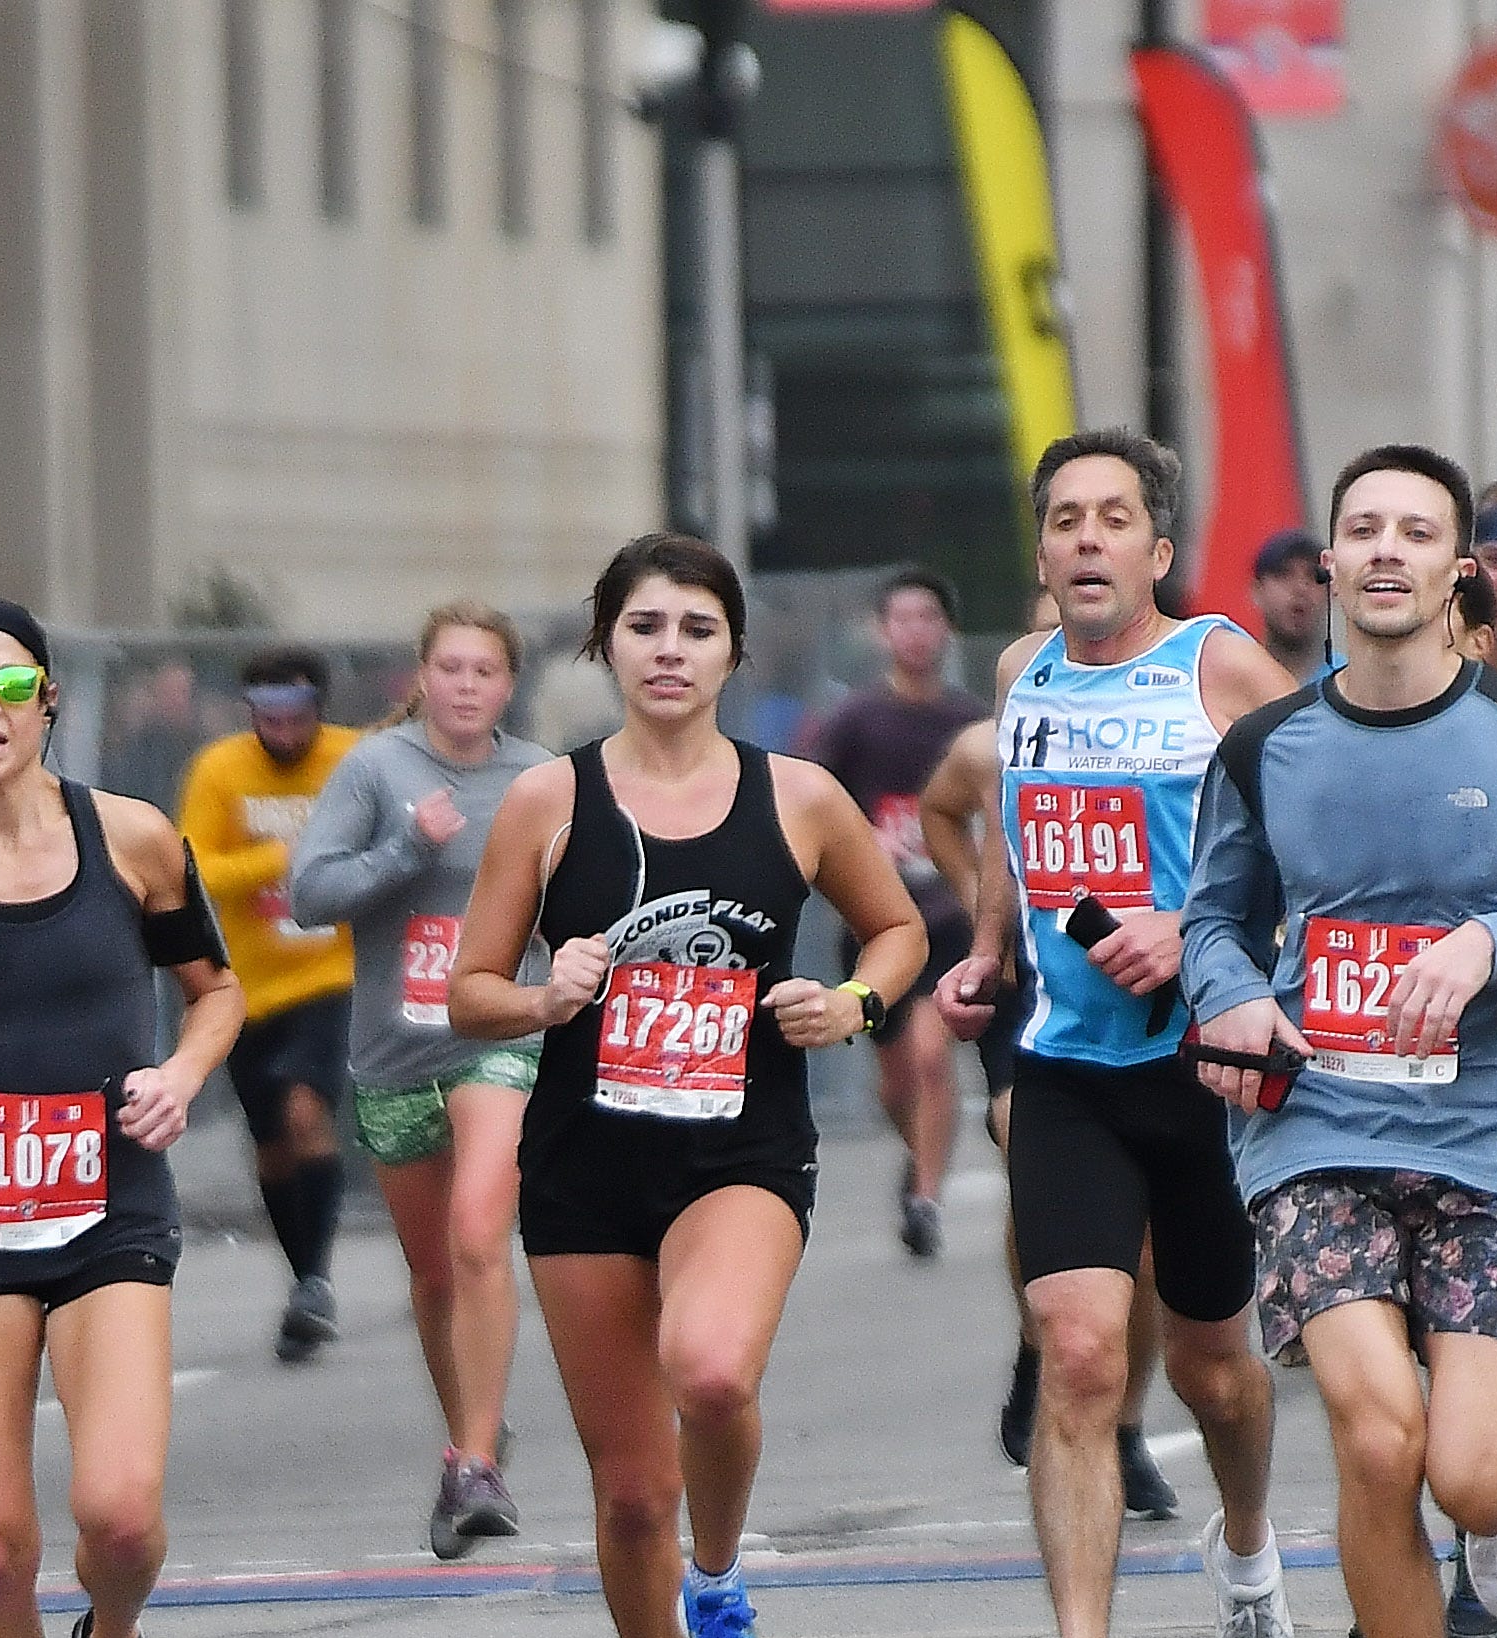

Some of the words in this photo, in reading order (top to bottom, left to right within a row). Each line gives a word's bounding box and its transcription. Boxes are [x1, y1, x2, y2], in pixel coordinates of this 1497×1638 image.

[1066, 716, 1188, 751] HOPE
[1068, 756, 1112, 770] WATER
[1116, 757, 1183, 772] PROJECT
[1023, 820, 1144, 874] 16191
[607, 993, 749, 1056] 17268
